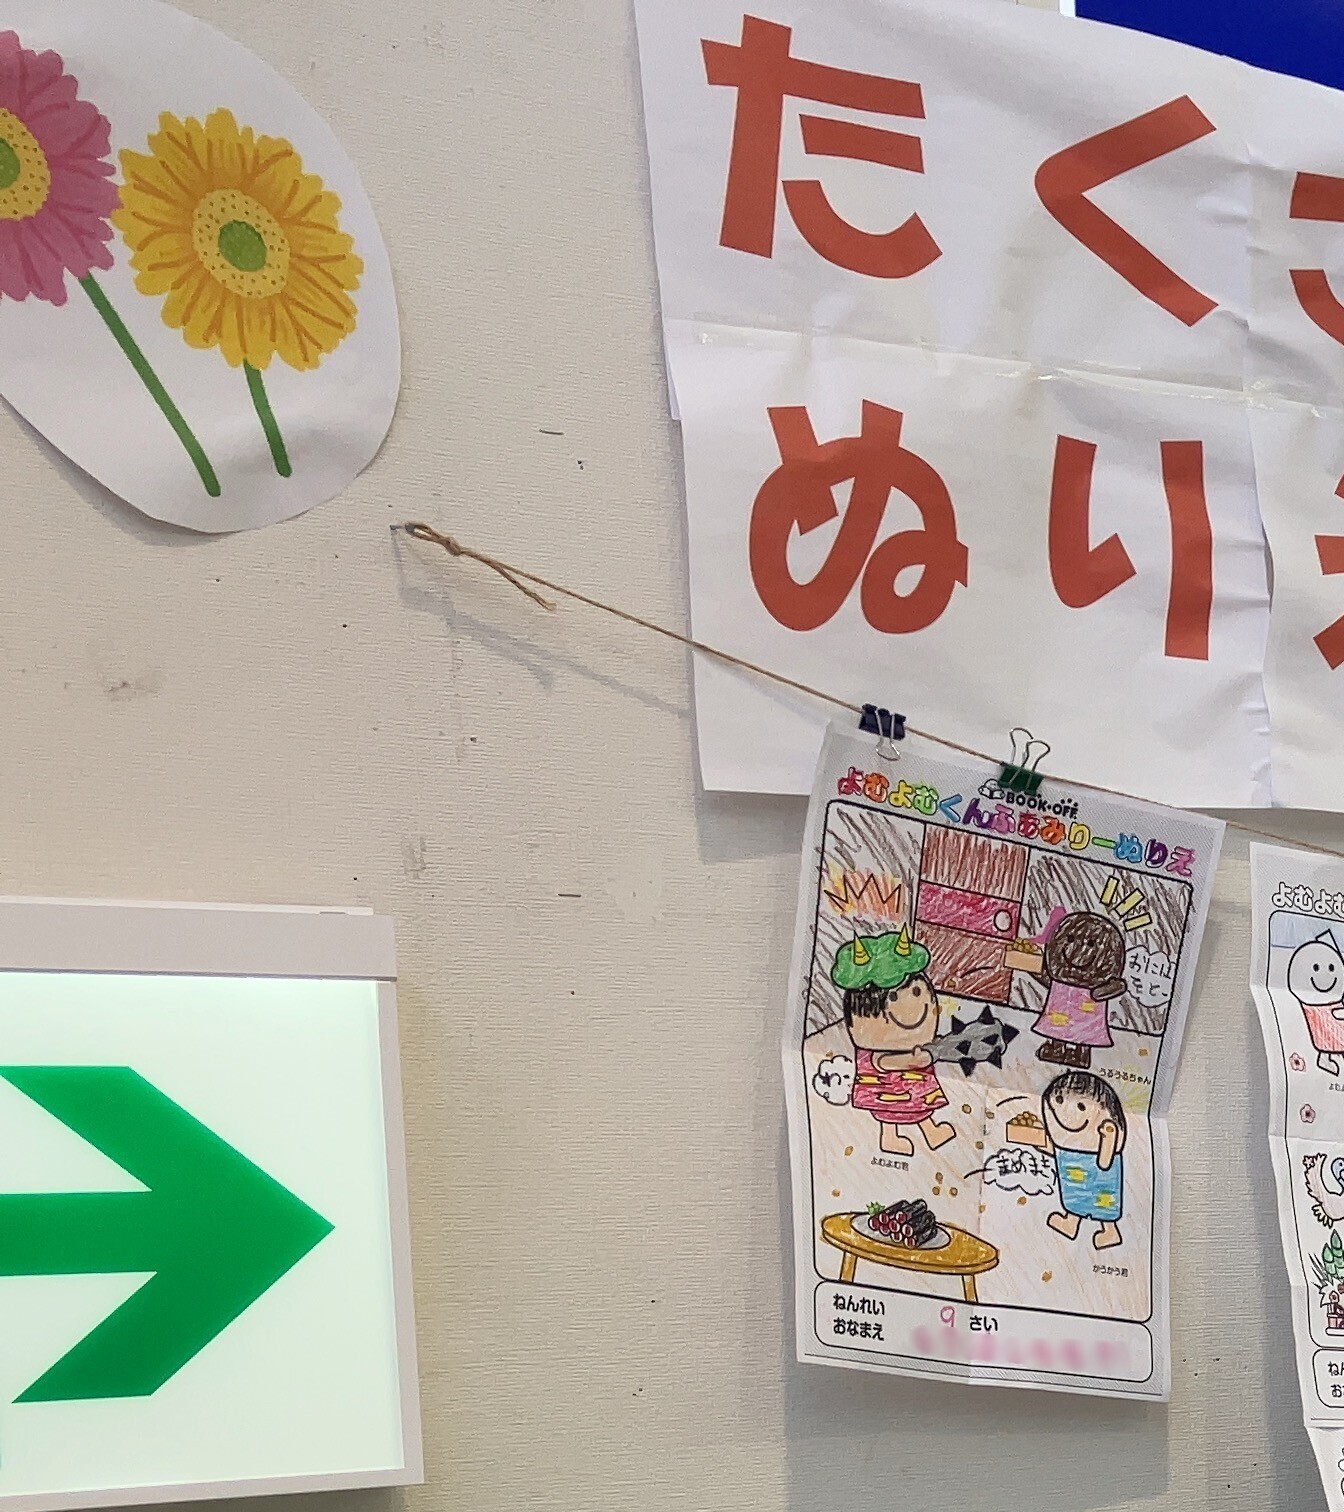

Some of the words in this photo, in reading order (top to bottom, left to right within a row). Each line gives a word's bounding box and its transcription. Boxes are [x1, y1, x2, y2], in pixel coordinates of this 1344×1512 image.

[832, 1293, 885, 1316] ねんれい
[940, 1305, 956, 1328] 9
[969, 1314, 999, 1333] さい
[832, 1318, 885, 1342] おなまえ
